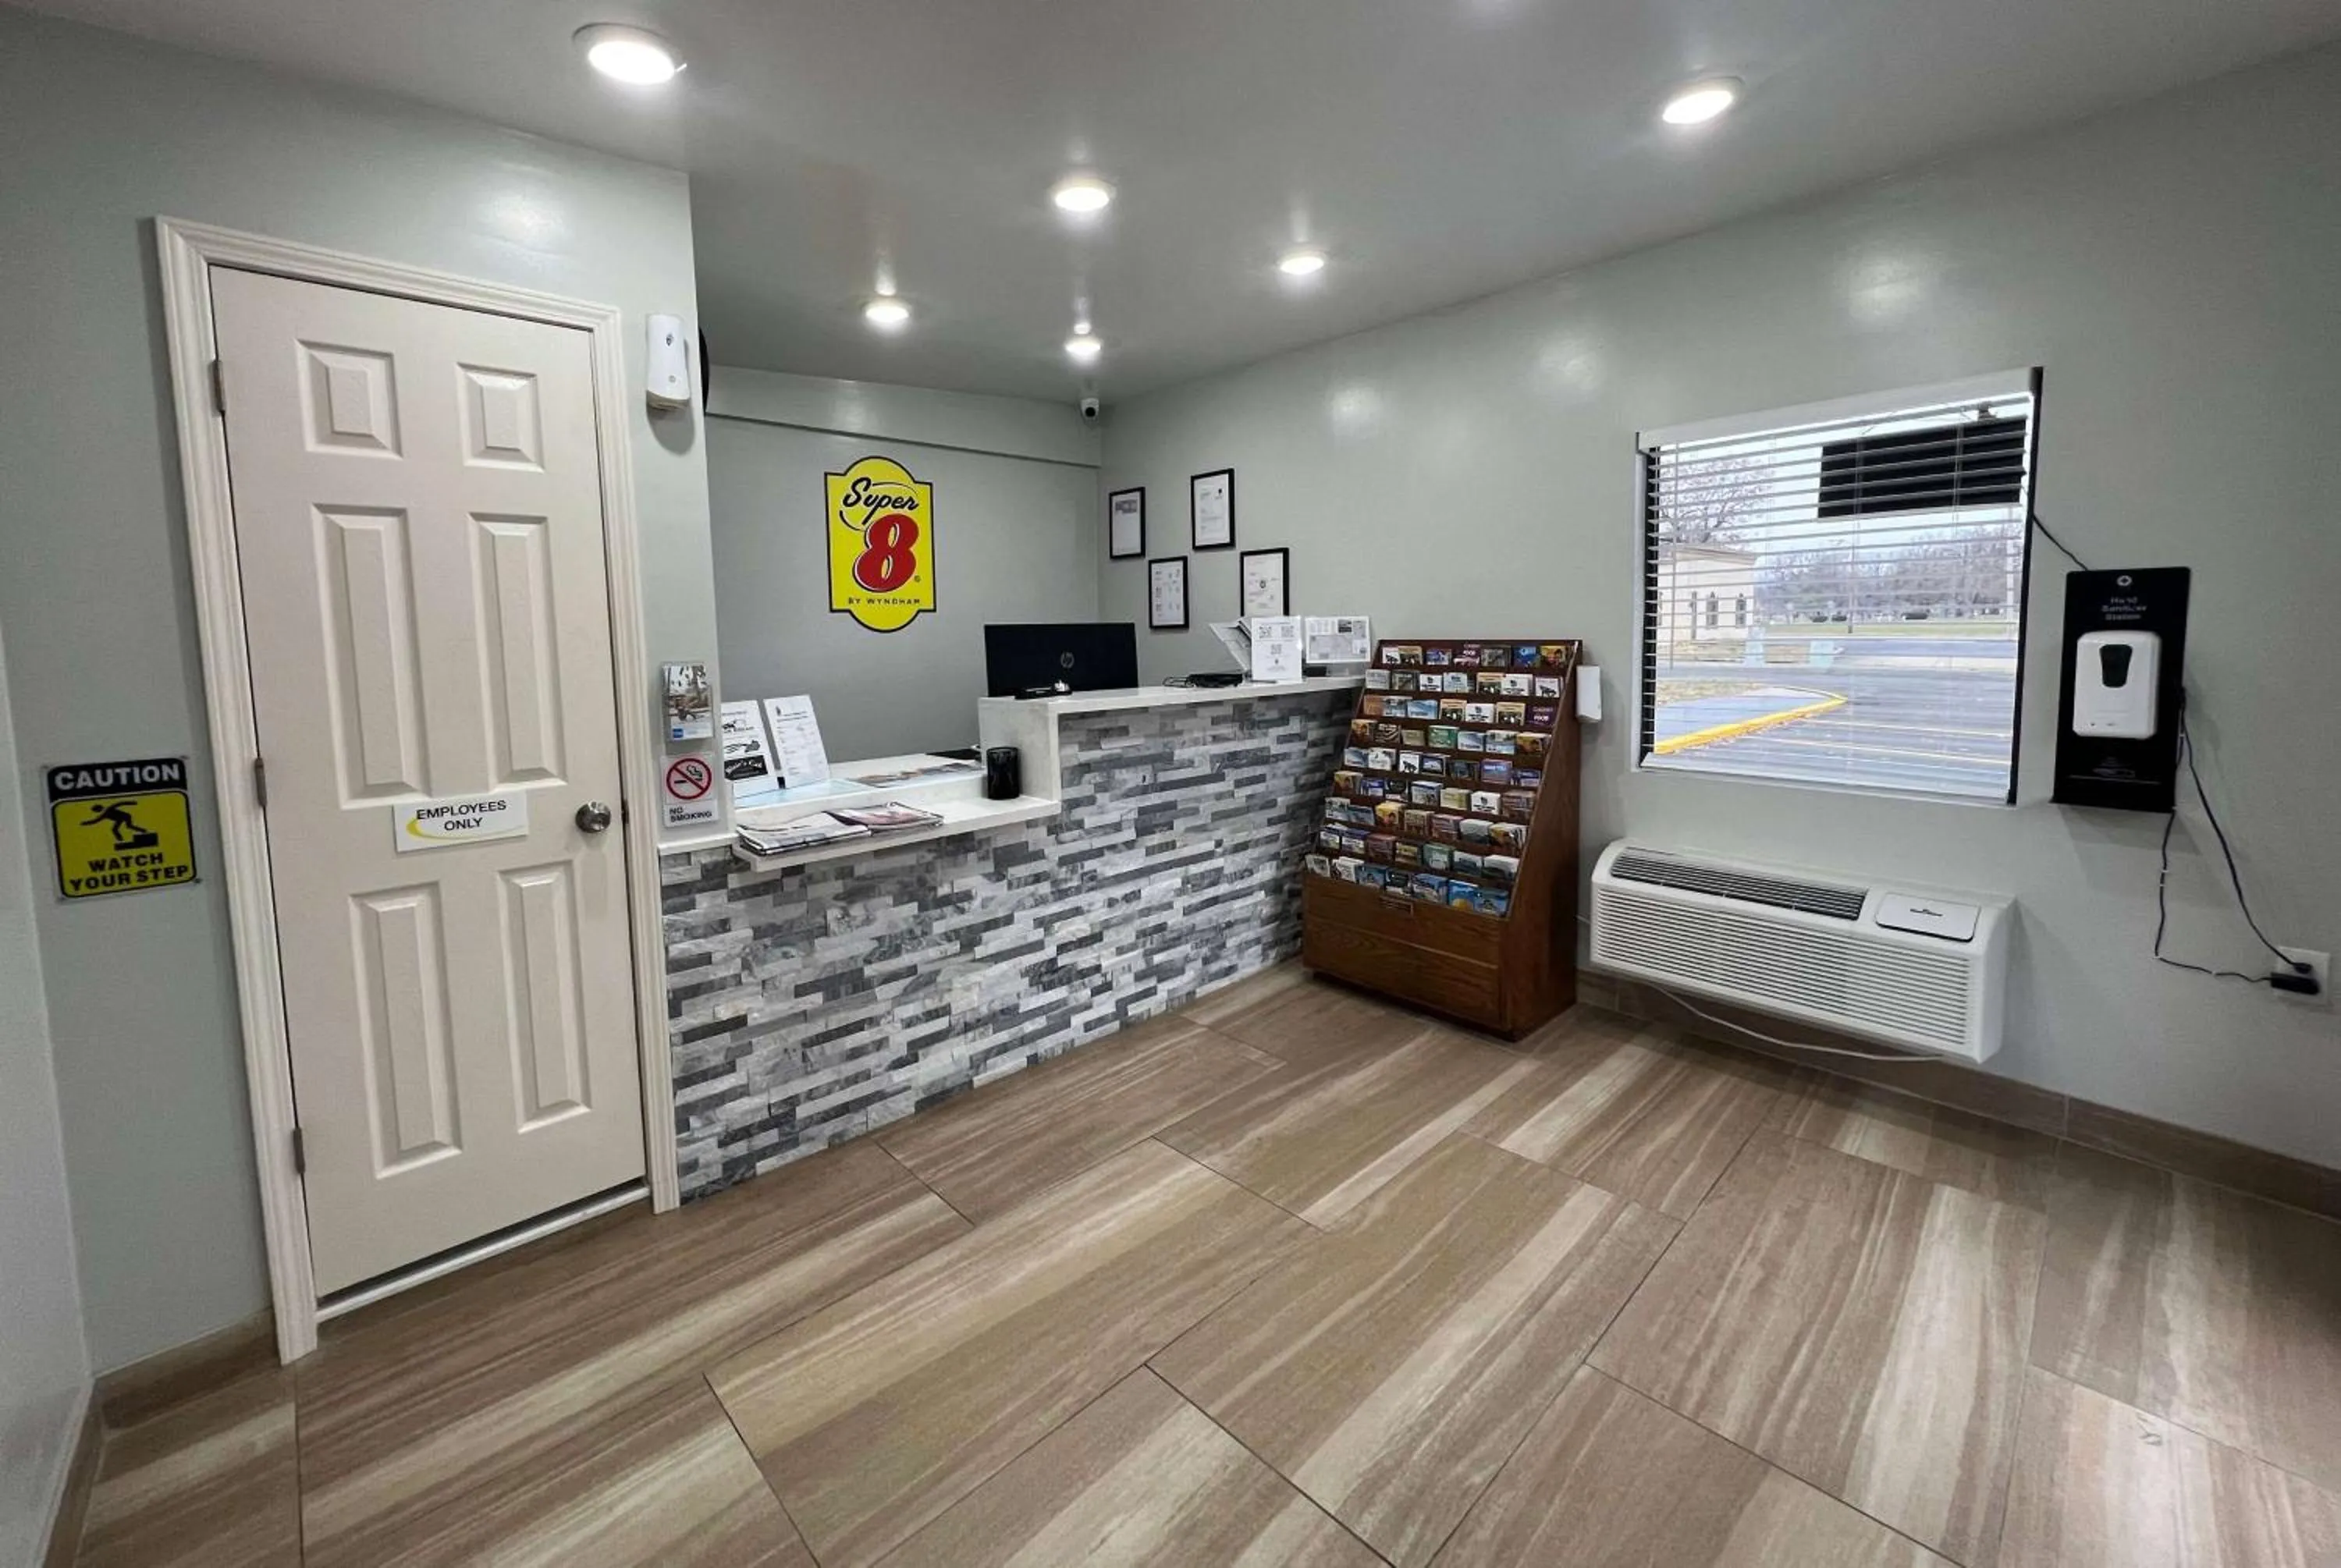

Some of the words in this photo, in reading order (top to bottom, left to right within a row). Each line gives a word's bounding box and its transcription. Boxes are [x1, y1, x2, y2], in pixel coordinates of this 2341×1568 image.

[843, 477, 919, 525] Super
[853, 513, 919, 592] 8
[55, 764, 180, 790] CAUTION
[417, 800, 506, 820] EMPLOYEES
[669, 807, 684, 815] NO
[669, 811, 712, 823] SMOKING
[444, 818, 483, 831] ONLY
[87, 852, 164, 873] WATCH
[69, 873, 131, 892] YOUR
[136, 865, 189, 883] STEP
